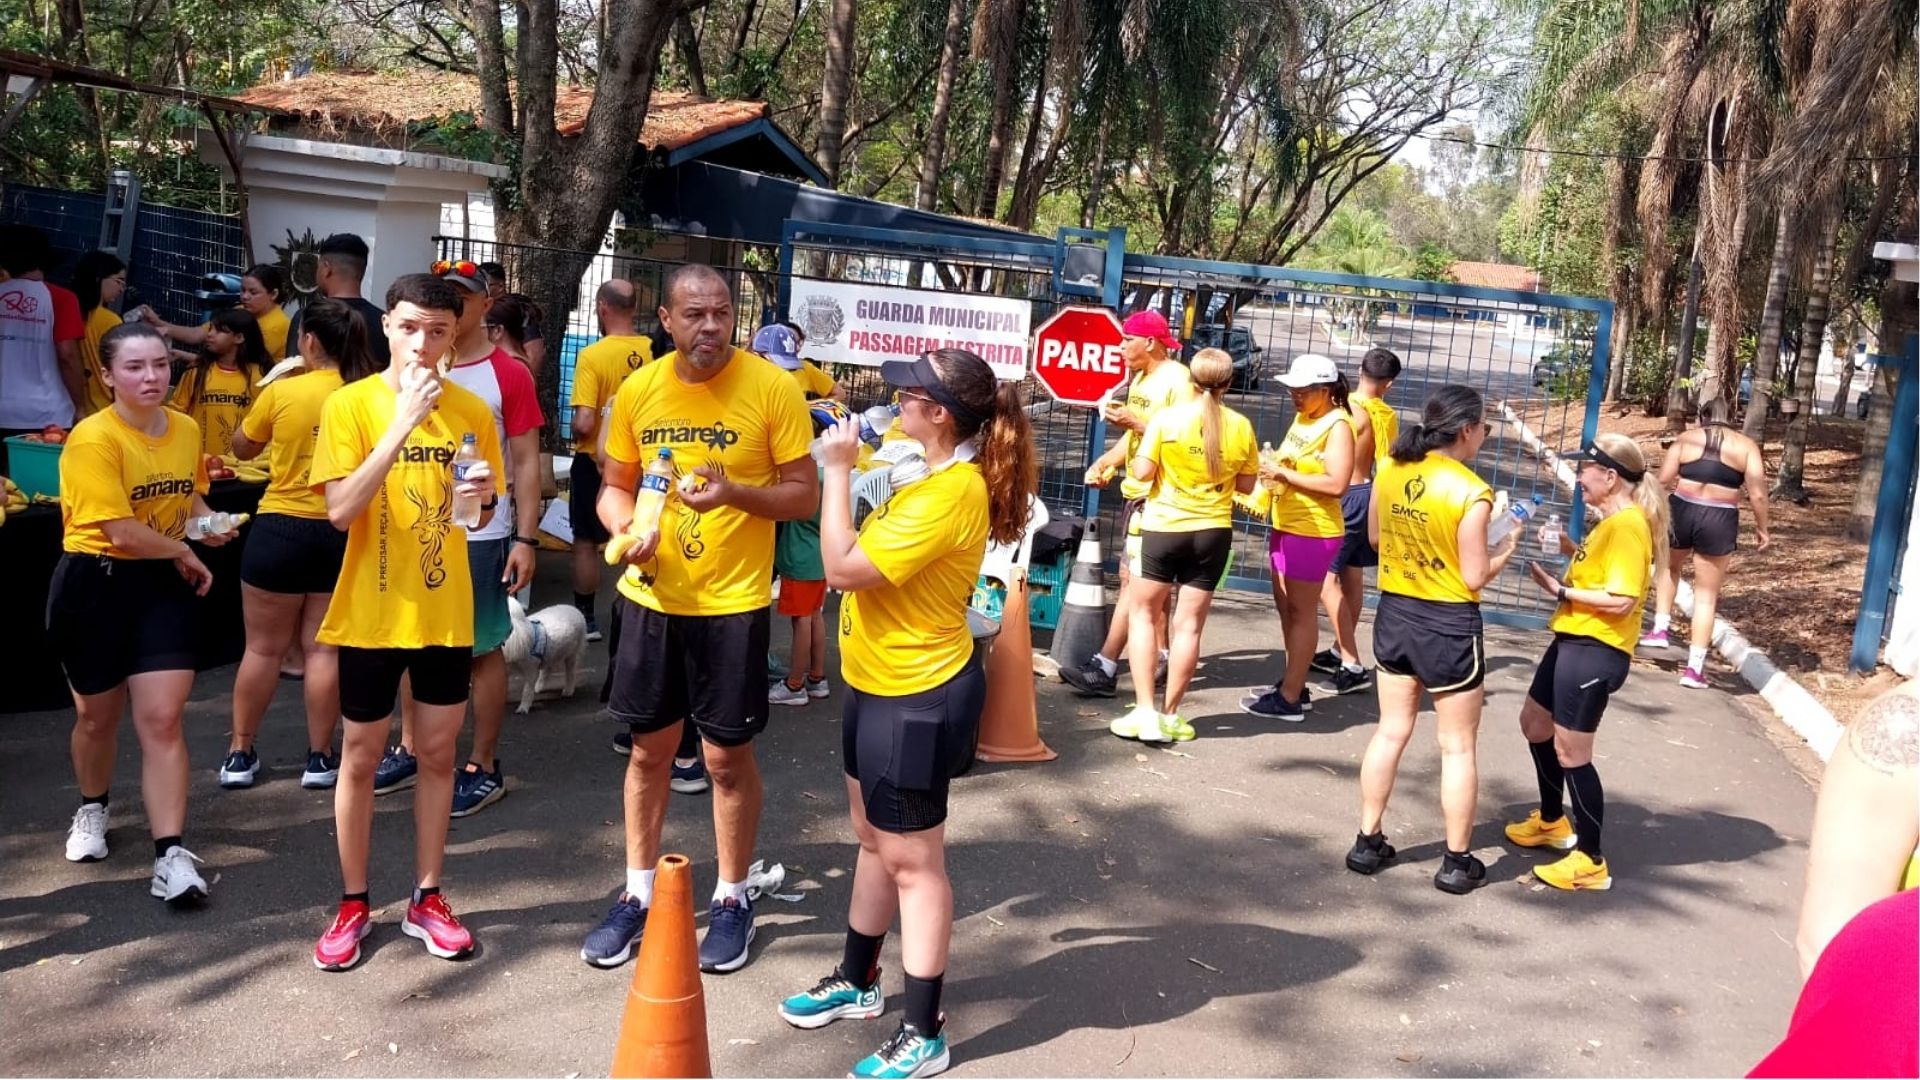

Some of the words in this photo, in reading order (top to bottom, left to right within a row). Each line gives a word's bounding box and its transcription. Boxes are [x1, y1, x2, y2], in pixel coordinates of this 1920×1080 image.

[856, 299, 925, 325] GUARDA
[928, 306, 1021, 333] MUNICIPAL
[849, 330, 940, 357] PASSAGEM
[1041, 338, 1121, 375] PARE
[1391, 503, 1429, 523] SMCC
[379, 580, 388, 593] SE
